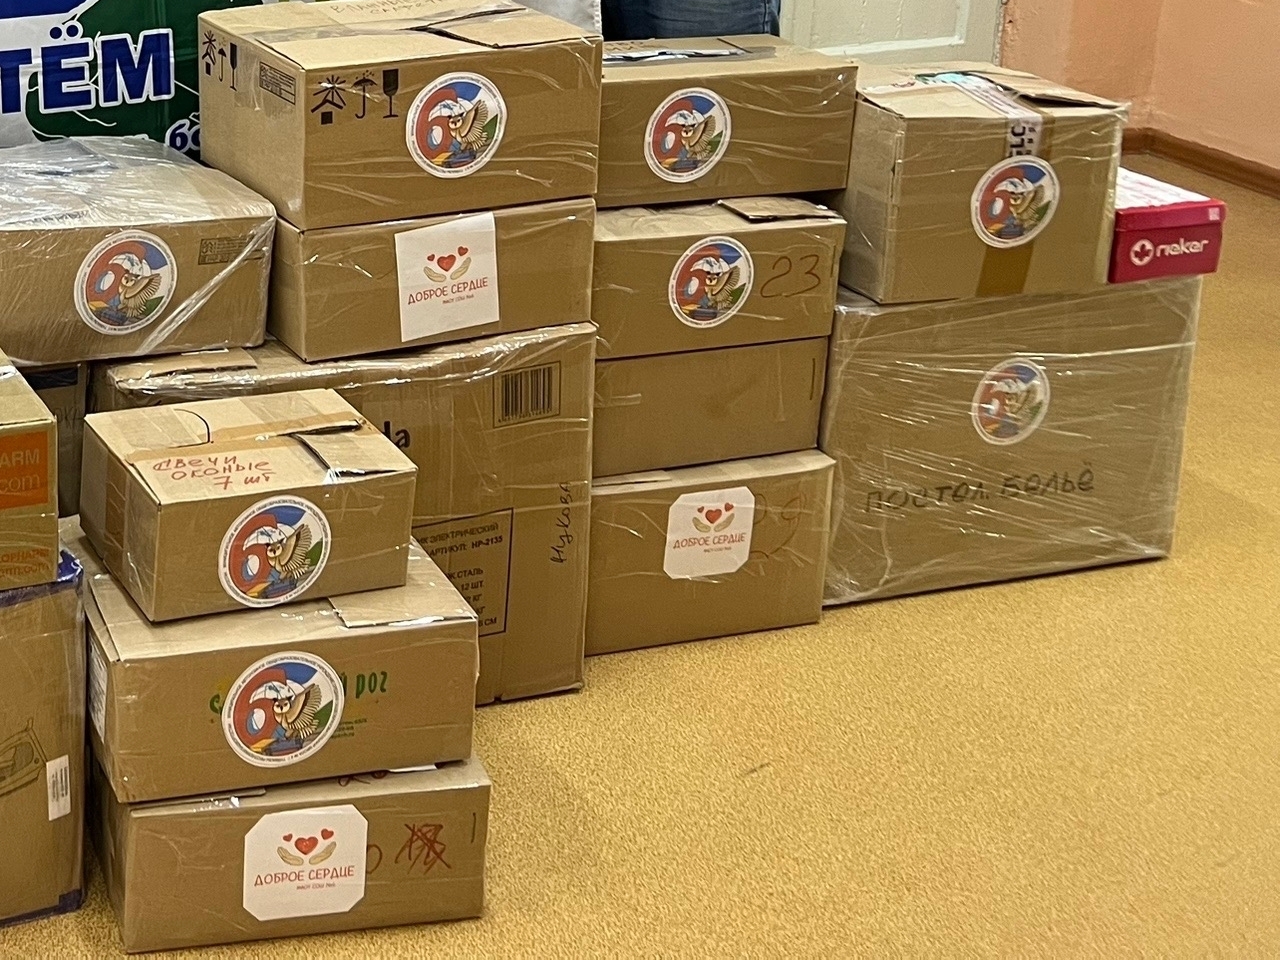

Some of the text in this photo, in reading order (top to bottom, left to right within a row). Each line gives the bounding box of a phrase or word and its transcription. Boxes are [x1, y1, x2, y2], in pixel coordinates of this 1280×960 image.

[760, 254, 820, 298] 23
[408, 277, 489, 305] ДОБРОЕ СЕРДЦЕ
[673, 533, 746, 549] ДОБРОЕ СЕРДЦЕ
[254, 865, 355, 887] ДОБРОЕ СЕРДЦЕ
